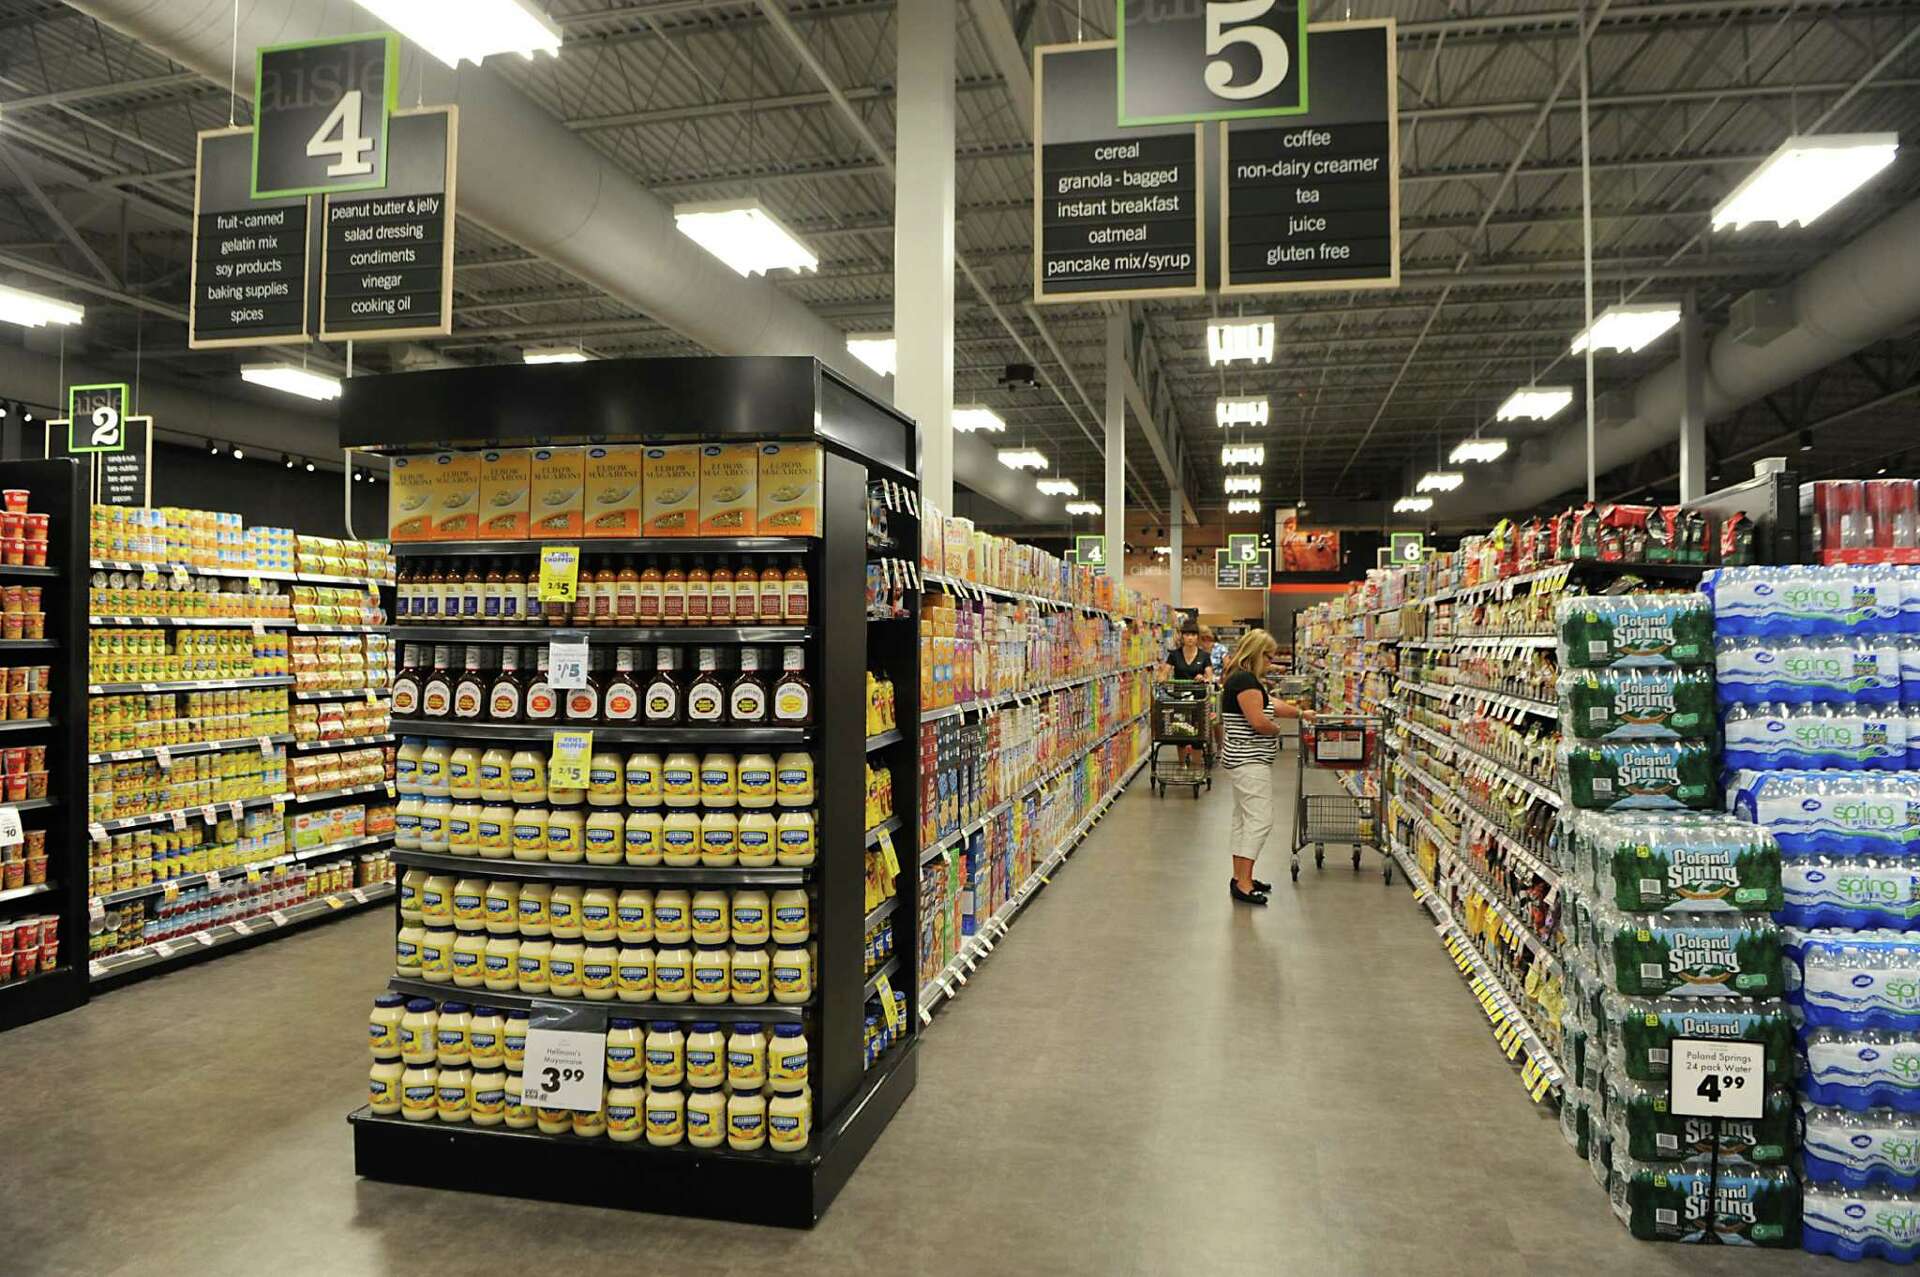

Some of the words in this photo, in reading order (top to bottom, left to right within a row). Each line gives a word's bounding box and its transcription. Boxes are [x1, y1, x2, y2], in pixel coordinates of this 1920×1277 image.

[1203, 0, 1289, 100] 5
[307, 91, 375, 179] 4
[1284, 130, 1331, 147] coffee
[1095, 142, 1139, 160] cereal
[1238, 160, 1310, 178] non-dairy
[1314, 158, 1379, 174] creamer
[1059, 172, 1112, 193] granola
[1124, 167, 1177, 187] bagged
[1296, 188, 1319, 203] tea
[330, 201, 369, 221] peanut
[373, 202, 405, 215] butter
[407, 200, 415, 213] &
[417, 198, 439, 215] jelly
[1058, 200, 1106, 217] instant
[1112, 196, 1179, 214] breakfast
[345, 226, 373, 241] salad
[376, 224, 423, 239] dressing
[1089, 225, 1146, 243] oatmeal
[1288, 216, 1326, 235] juice
[221, 237, 255, 255] gelatin
[259, 235, 277, 249] mix
[1267, 246, 1314, 265] gluten
[1320, 243, 1349, 259] free
[350, 249, 415, 265] condiments
[1048, 256, 1110, 277] pancake
[1115, 253, 1190, 271] mix/syrup
[216, 265, 233, 277] soy
[236, 259, 281, 276] products
[208, 286, 242, 300] baking
[246, 282, 288, 298] supplies
[362, 275, 402, 289] vinegar
[351, 298, 395, 314] cooking
[398, 296, 410, 310] oil
[231, 308, 263, 323] spices
[92, 406, 118, 445] 2
[1088, 546, 1102, 562] 4
[1241, 544, 1256, 561] 5
[1404, 542, 1420, 561] 6
[1784, 585, 1840, 608] spring
[1619, 614, 1667, 628] Poland
[1613, 626, 1676, 648] Spring
[1784, 654, 1841, 677] spring
[1620, 681, 1668, 695] Poland
[1614, 693, 1677, 716] Spring
[1796, 722, 1851, 745] spring
[1623, 752, 1671, 767] Poland
[1617, 764, 1680, 787] Spring
[1833, 801, 1894, 825] spring
[1673, 849, 1730, 866] Poland
[1667, 864, 1740, 889] Spring
[1837, 875, 1898, 899] spring
[1674, 933, 1730, 949] Poland
[1668, 948, 1741, 974] Spring
[1682, 1017, 1740, 1035] Poland
[1687, 1051, 1716, 1060] Poland
[1719, 1053, 1751, 1064] Springs
[1701, 1064, 1721, 1072] pack
[1725, 1064, 1752, 1072] Water
[1685, 1119, 1757, 1146] Sping
